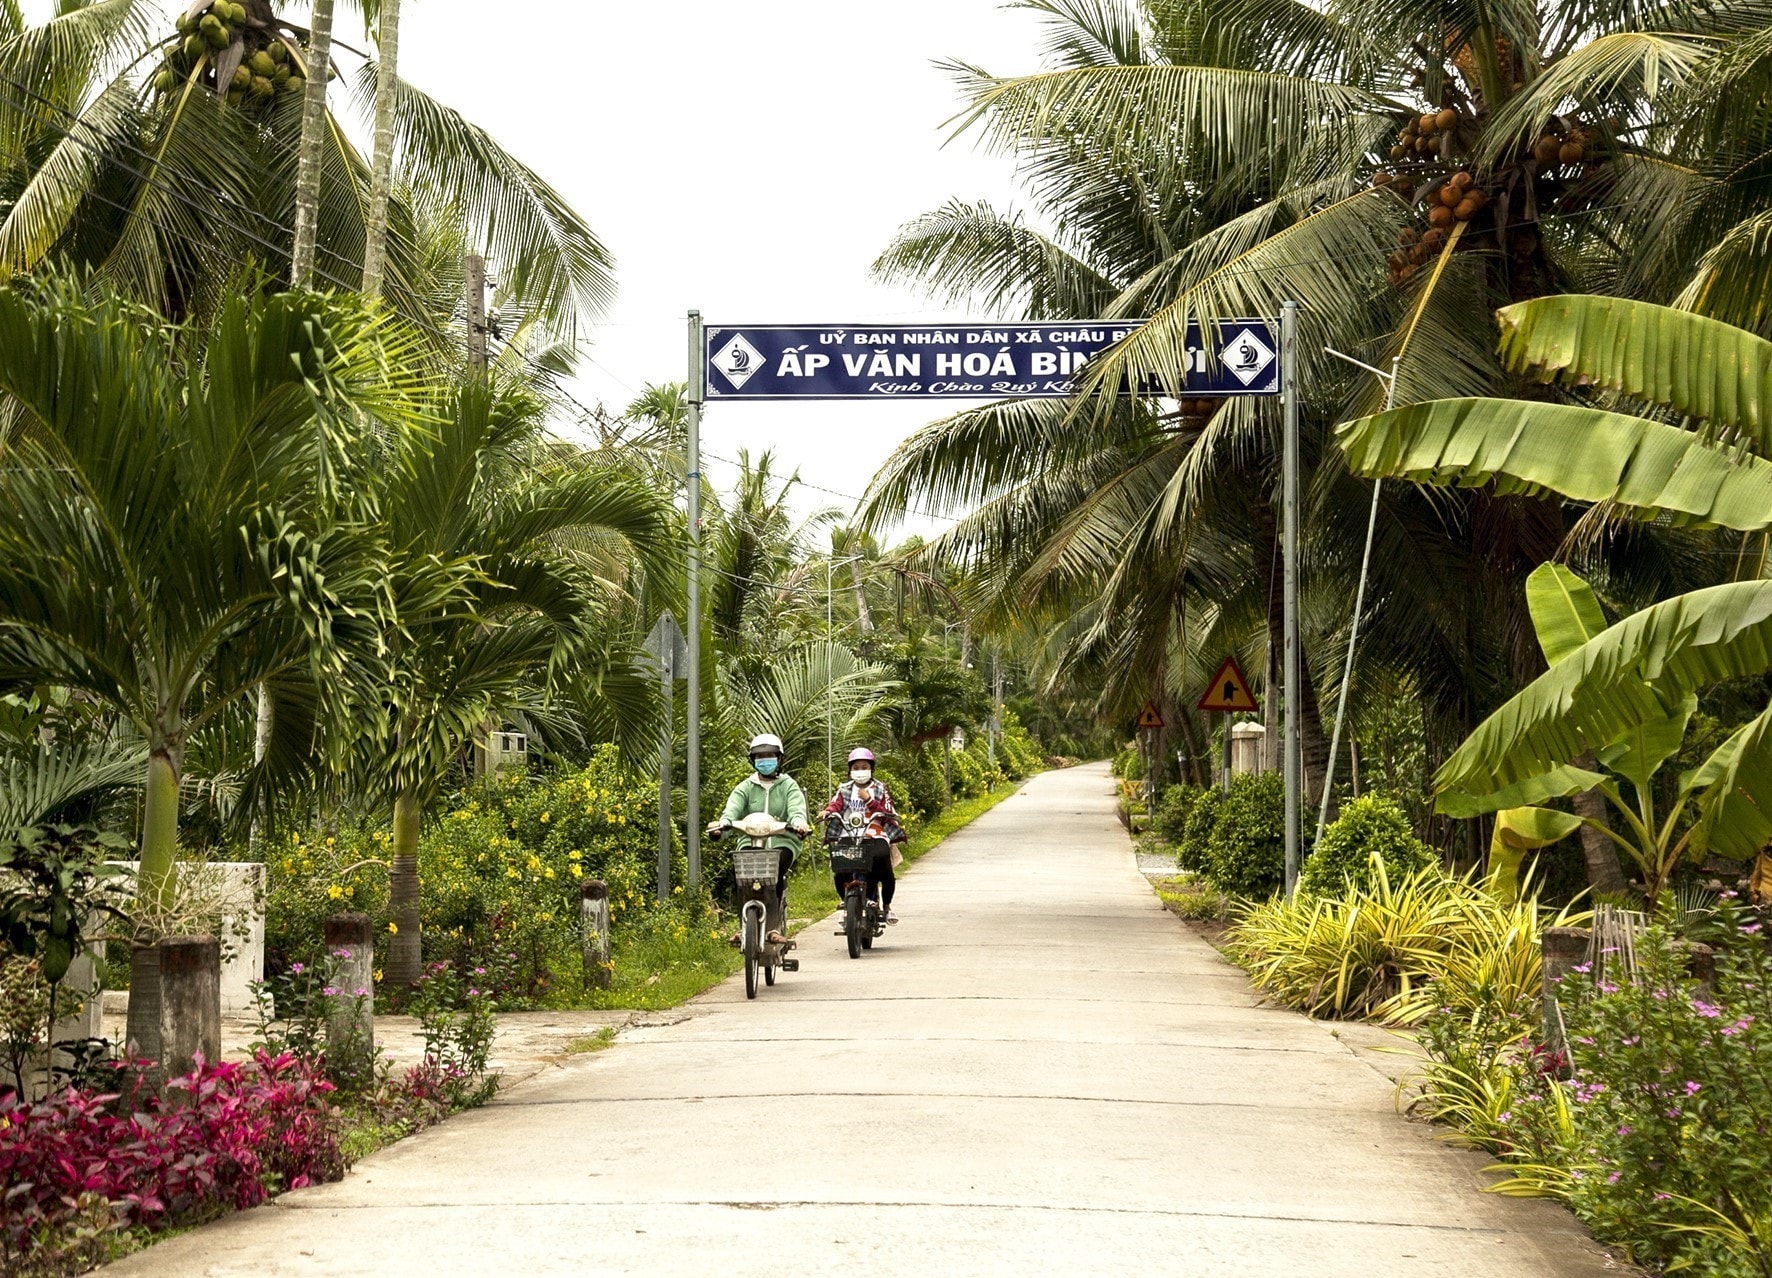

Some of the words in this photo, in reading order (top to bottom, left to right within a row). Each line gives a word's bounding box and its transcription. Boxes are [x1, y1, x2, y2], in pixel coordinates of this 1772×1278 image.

[819, 329, 847, 345] UỶ
[853, 333, 896, 345] BAN
[903, 330, 959, 344] NHÂN
[966, 330, 1009, 344] DÂN
[1014, 329, 1043, 343] XÃ
[1048, 328, 1105, 343] CHÂU
[776, 344, 831, 377] ẤP
[841, 349, 921, 377] VĂN
[936, 346, 1017, 377] HOÁ
[868, 382, 922, 394] Kính
[927, 381, 984, 394] Chào
[990, 381, 1037, 394] Quý
